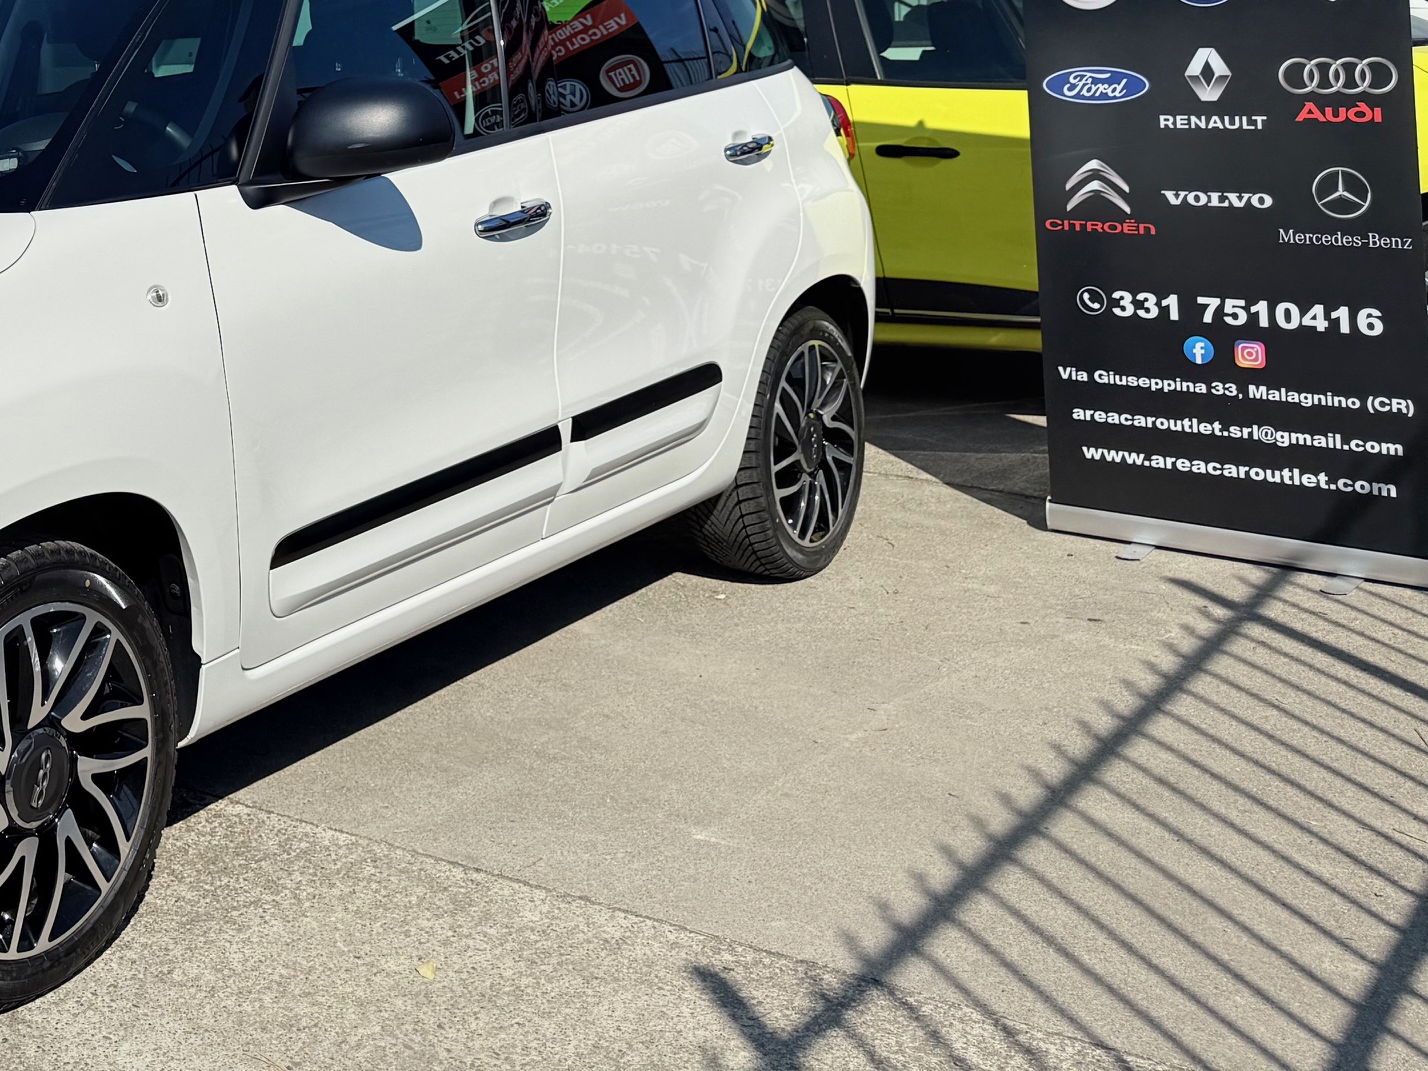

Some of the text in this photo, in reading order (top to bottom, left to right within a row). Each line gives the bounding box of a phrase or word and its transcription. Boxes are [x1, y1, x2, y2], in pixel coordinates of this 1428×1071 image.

[1063, 71, 1127, 99] Ford
[1159, 114, 1267, 130] RENAULT
[1161, 190, 1273, 209] VOLVO
[1278, 229, 1413, 250] Mercedes-Benz
[1111, 290, 1384, 337] 331 7510416
[1057, 366, 1415, 417] Via Giuseppina 33, Malagnino (CR)
[1072, 406, 1404, 457] areacaroutlet.srl@gmail.com
[1082, 445, 1398, 498] www.areacaroutlet.com
